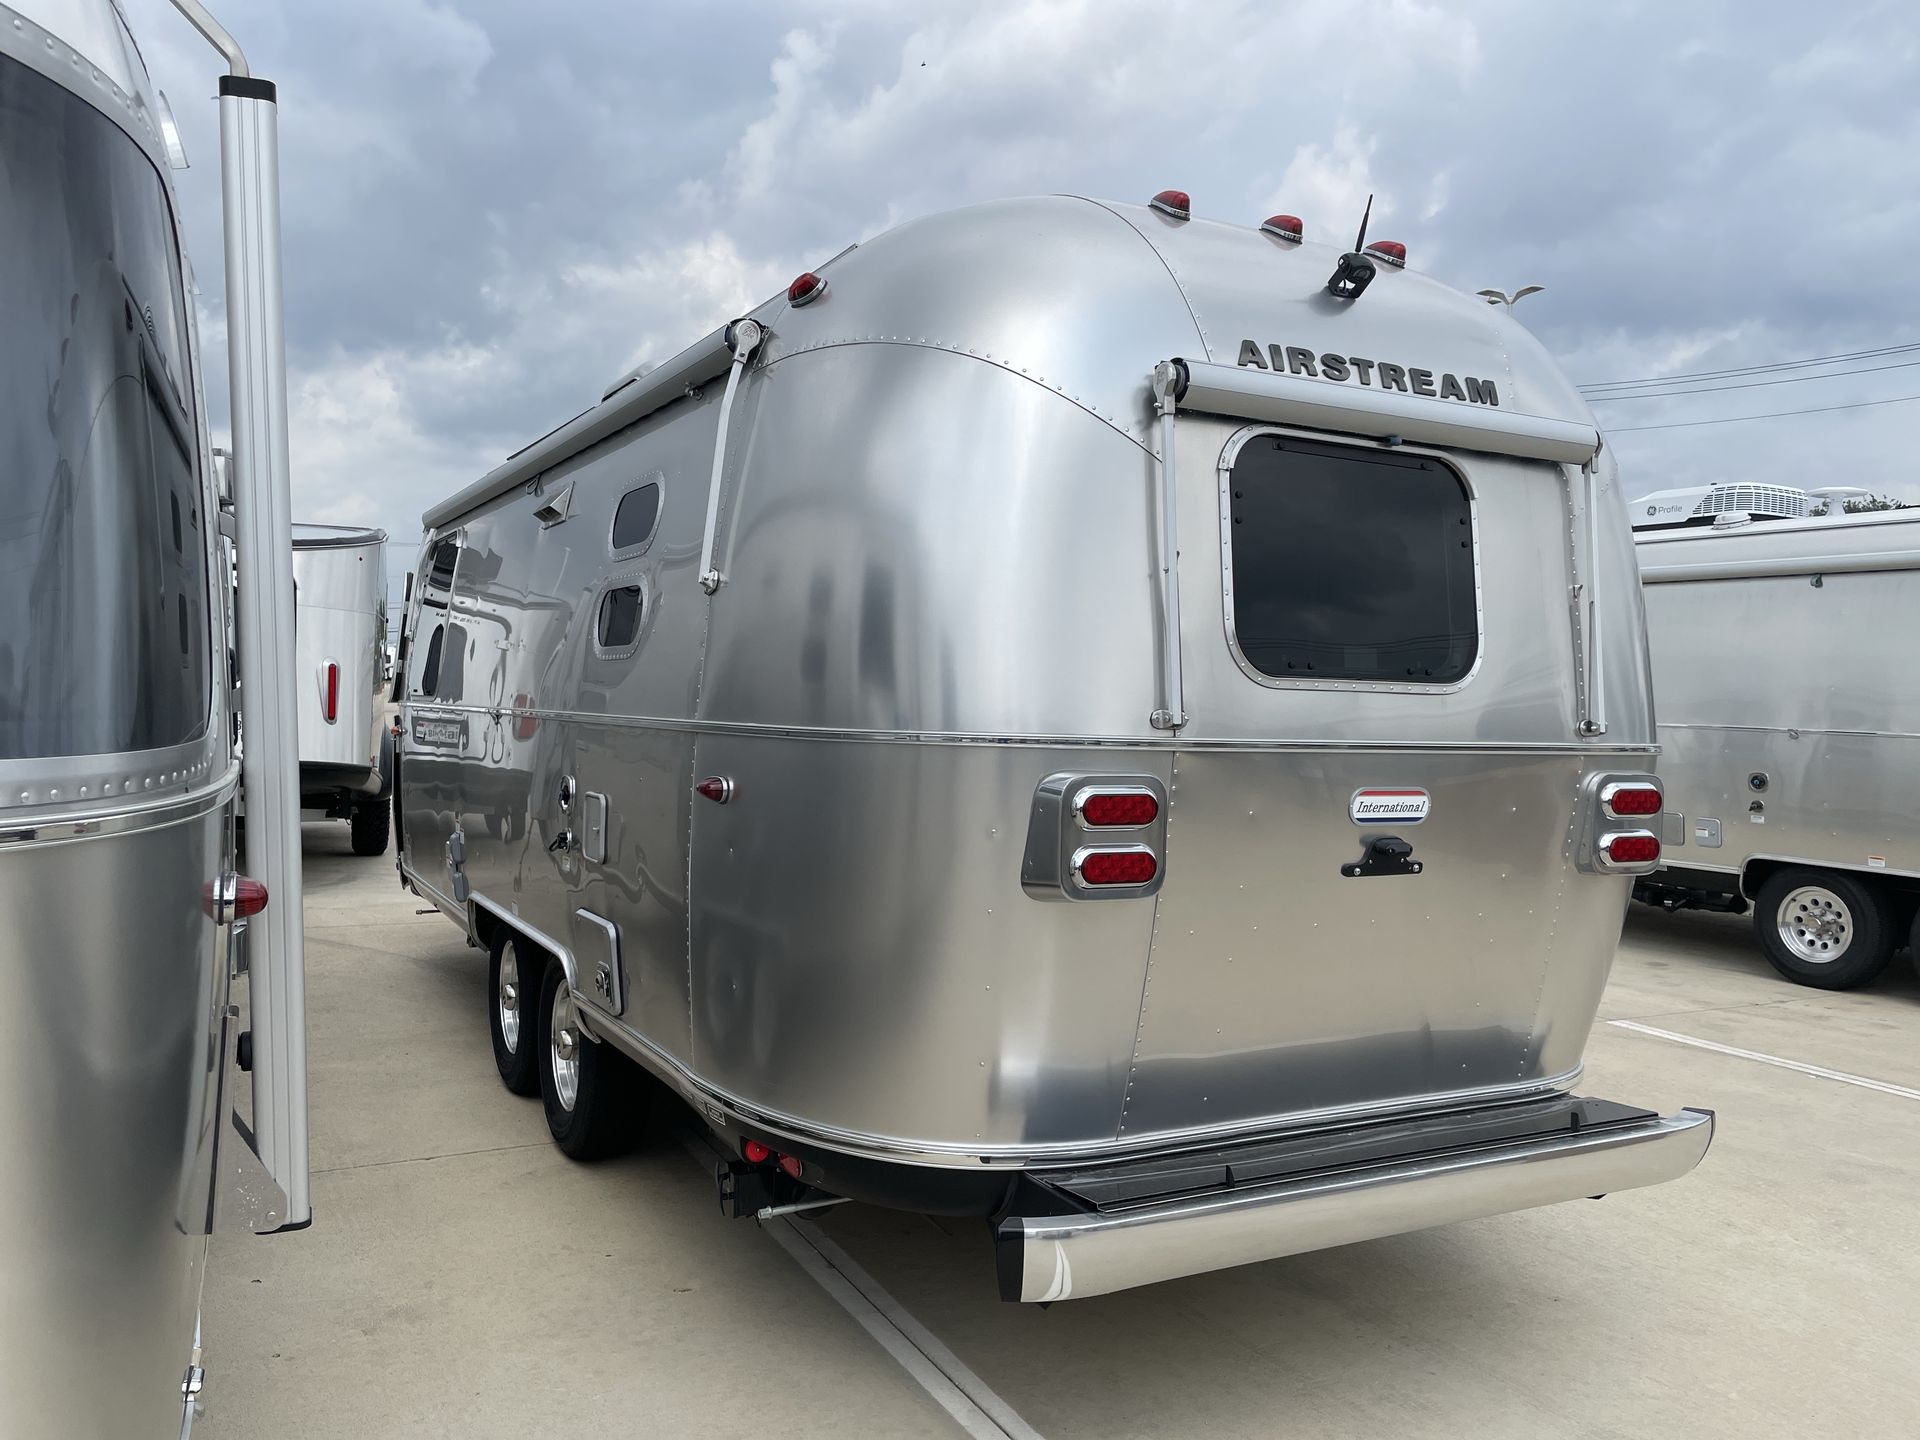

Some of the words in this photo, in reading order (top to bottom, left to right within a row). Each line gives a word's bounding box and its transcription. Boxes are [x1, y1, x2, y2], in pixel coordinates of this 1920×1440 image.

[1238, 339, 1499, 406] AIRSTREAM
[1658, 505, 1683, 515] Profile
[1356, 801, 1426, 813] International
